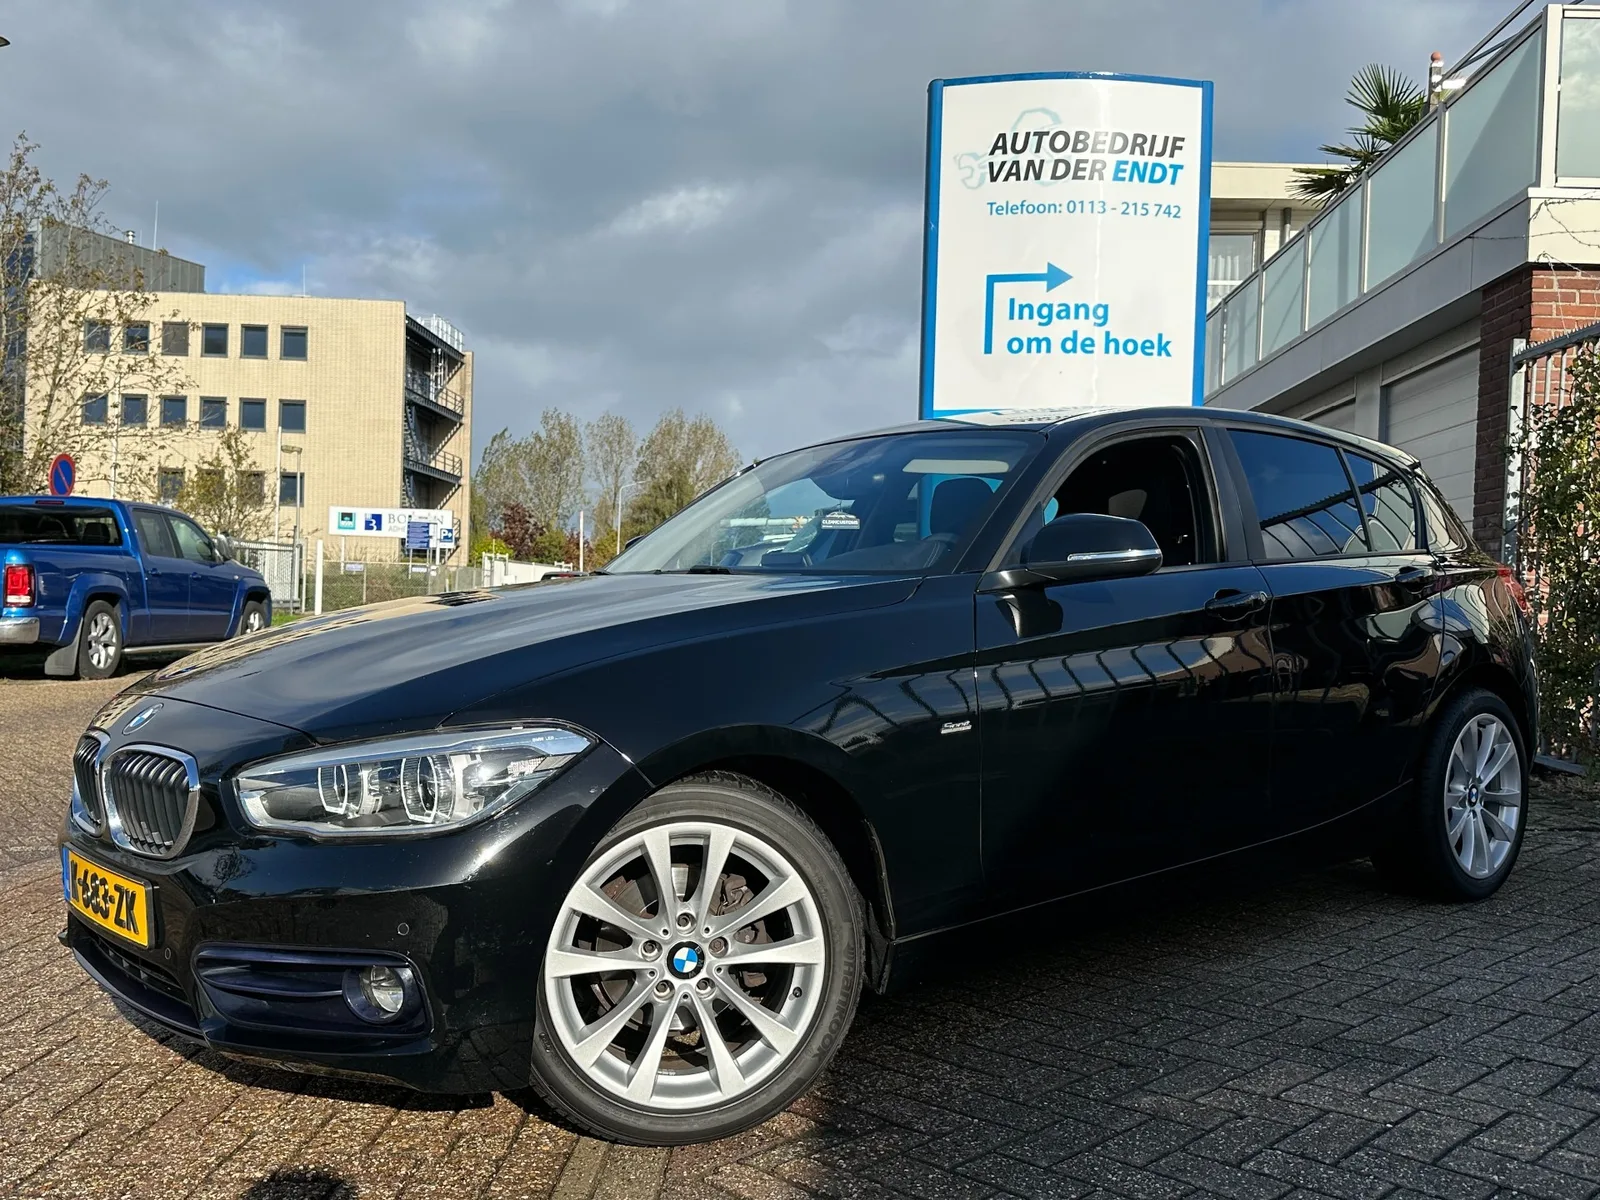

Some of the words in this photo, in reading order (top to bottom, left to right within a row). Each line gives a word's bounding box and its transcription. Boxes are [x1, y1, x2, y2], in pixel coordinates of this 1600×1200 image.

[989, 131, 1185, 159] AUTOBEDRIJF
[988, 159, 1045, 183] VAN
[1050, 159, 1107, 181] DER
[1112, 160, 1184, 185] ENDT
[987, 200, 1062, 216] Telefoon:
[1066, 200, 1106, 214] 0113
[1121, 202, 1149, 216] 215
[1154, 203, 1182, 219] 742
[1008, 298, 1109, 327] Ingang
[1006, 335, 1051, 355] om
[1060, 330, 1096, 355] de
[1104, 331, 1172, 357] hoek
